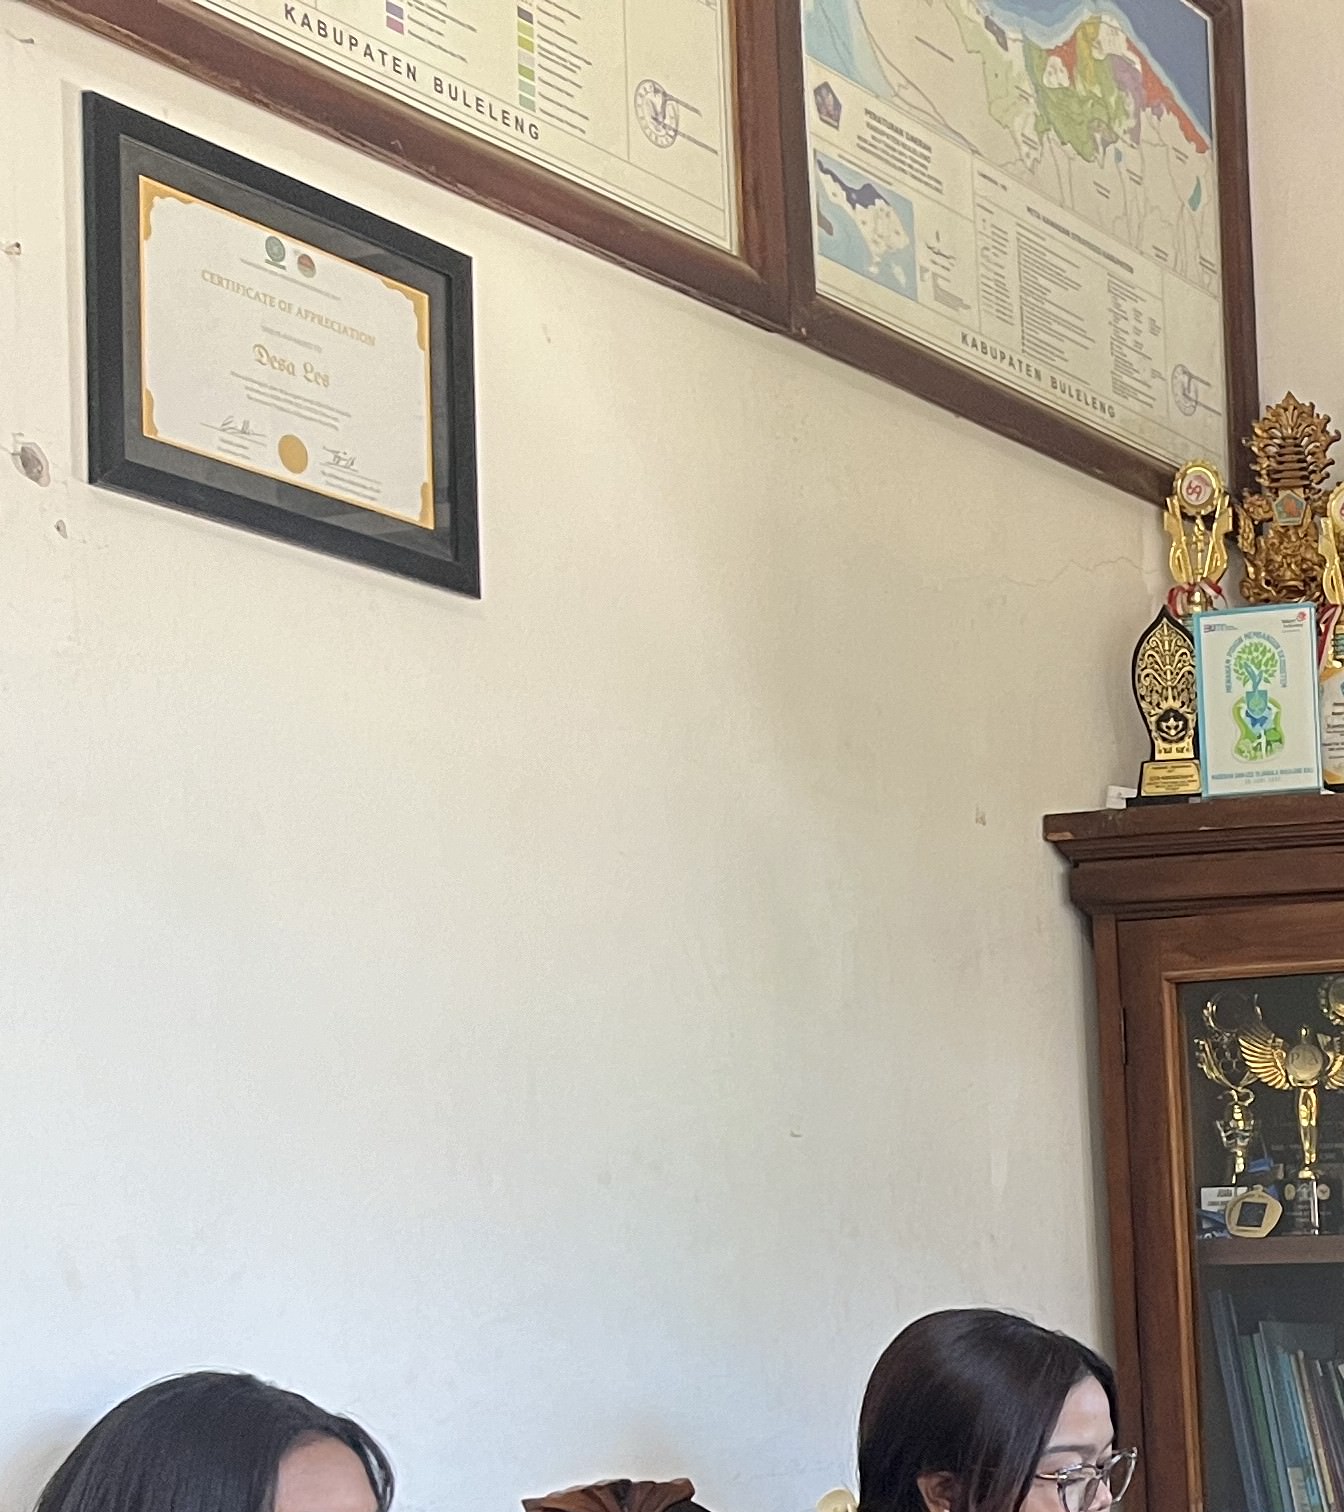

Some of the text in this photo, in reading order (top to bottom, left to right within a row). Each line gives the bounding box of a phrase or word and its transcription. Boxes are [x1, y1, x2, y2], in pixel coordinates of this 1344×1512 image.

[284, 3, 417, 82] KABUPATEN
[433, 76, 539, 141] BULELENG
[201, 269, 276, 308] CERTIFICATE
[278, 299, 293, 314] OF
[296, 305, 377, 347] APPRECIATION
[252, 343, 297, 377] Desa
[961, 332, 1116, 418] KABUPATEN BULELENG
